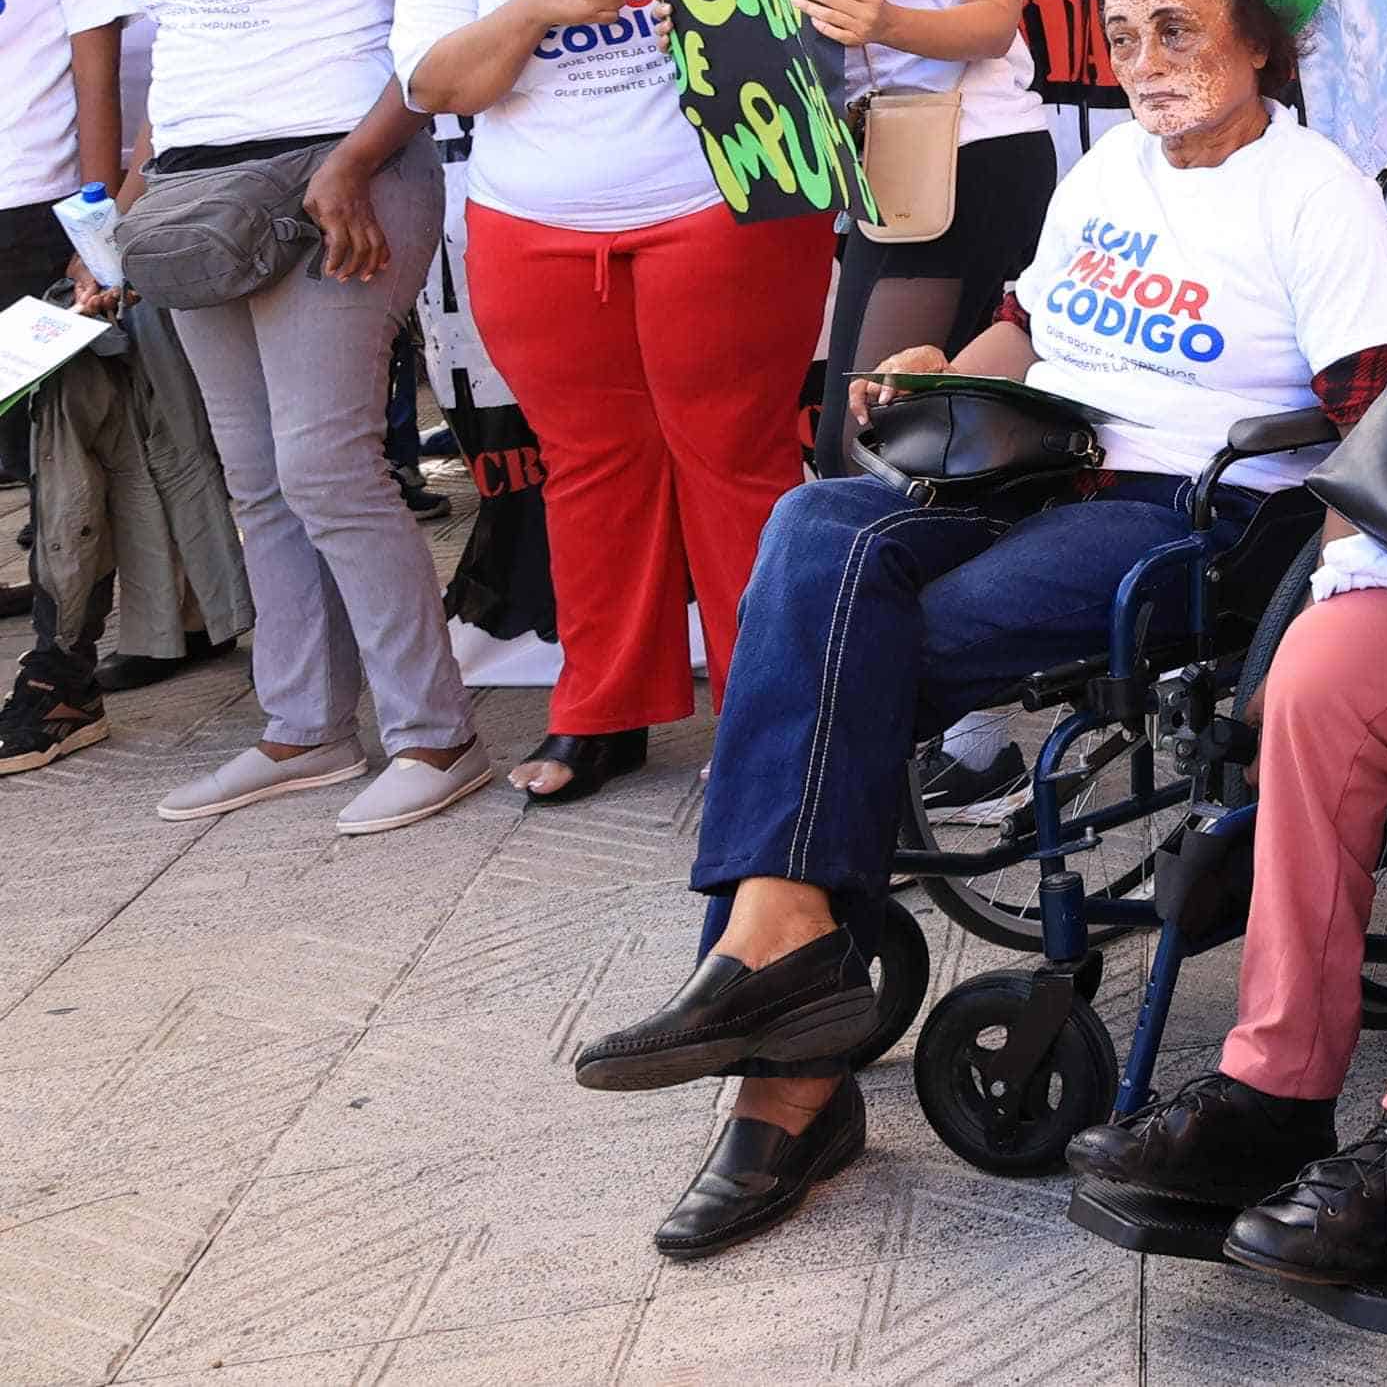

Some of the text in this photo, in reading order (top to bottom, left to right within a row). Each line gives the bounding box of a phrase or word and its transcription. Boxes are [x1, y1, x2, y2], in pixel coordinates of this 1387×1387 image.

[587, 46, 646, 66] PROTEJA
[568, 70, 594, 82] QUE
[598, 63, 643, 79] SUPERE
[645, 60, 661, 71] EL
[554, 87, 580, 98] QUE
[581, 78, 647, 97] ENFRENTE
[649, 75, 665, 87] LA
[1066, 250, 1209, 321] MEJOR
[1046, 279, 1225, 363] CODIGO
